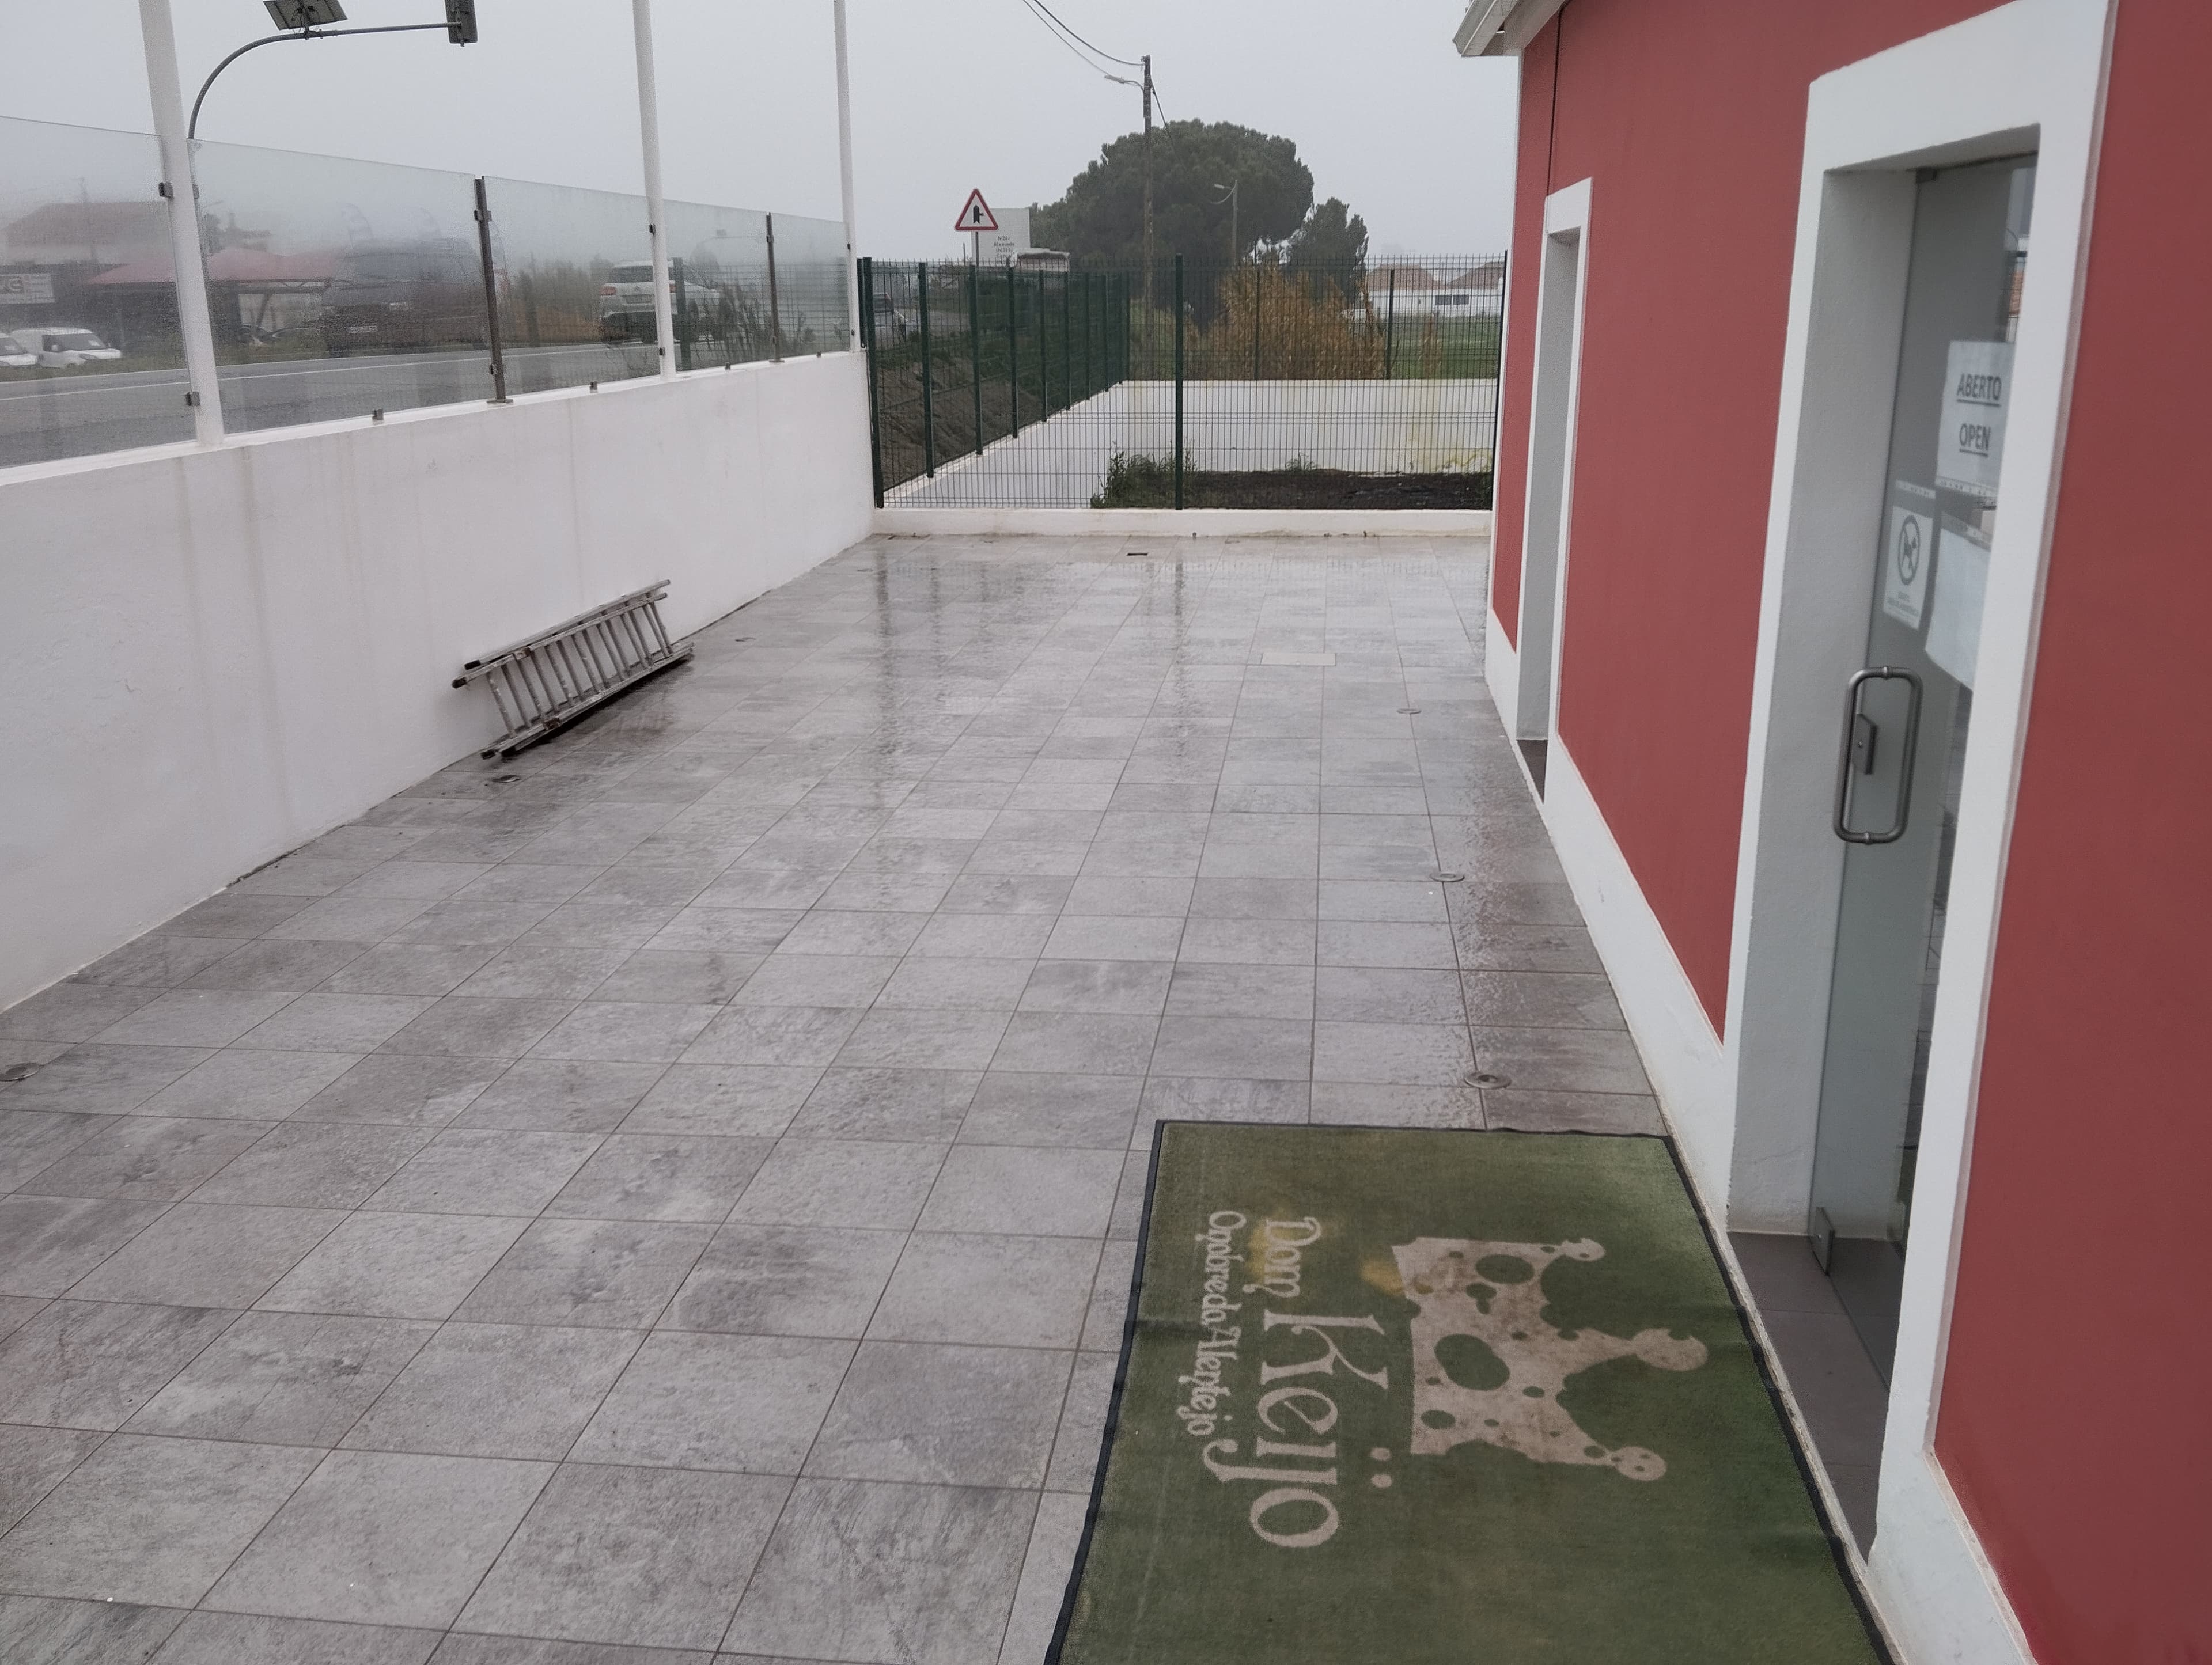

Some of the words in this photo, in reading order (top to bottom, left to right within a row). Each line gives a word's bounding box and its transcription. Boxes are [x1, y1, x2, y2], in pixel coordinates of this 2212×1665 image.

[1956, 373, 2002, 400] ABERTO
[1959, 423, 1991, 450] OPEN
[1242, 1216, 1322, 1299] Dom
[1176, 1325, 1243, 1437] Alentejo
